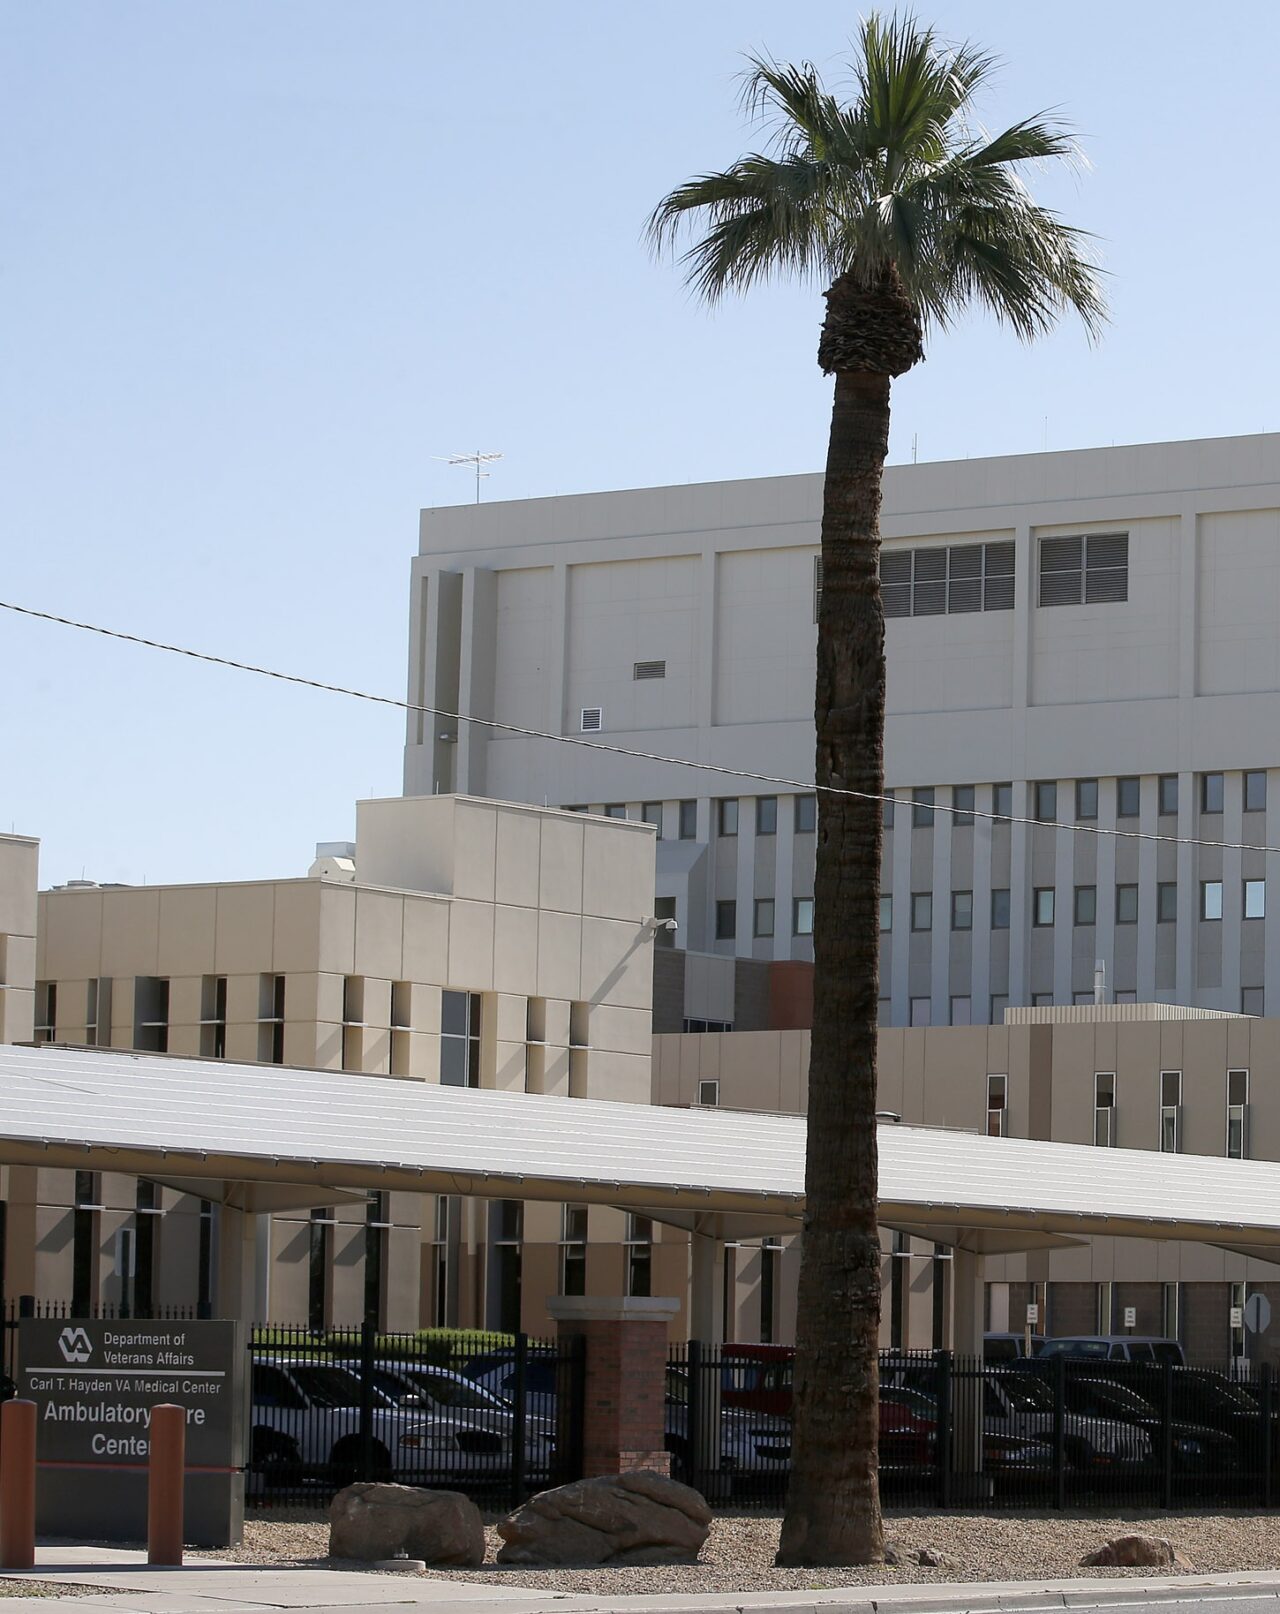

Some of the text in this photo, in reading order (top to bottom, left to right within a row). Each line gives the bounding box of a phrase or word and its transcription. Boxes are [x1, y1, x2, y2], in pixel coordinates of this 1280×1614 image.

[104, 1332, 186, 1348] Department of
[104, 1352, 194, 1366] Veterans Affairs
[30, 1377, 221, 1395] Carl T. Hayden VA Medical Center
[44, 1400, 151, 1429] Ambulatory
